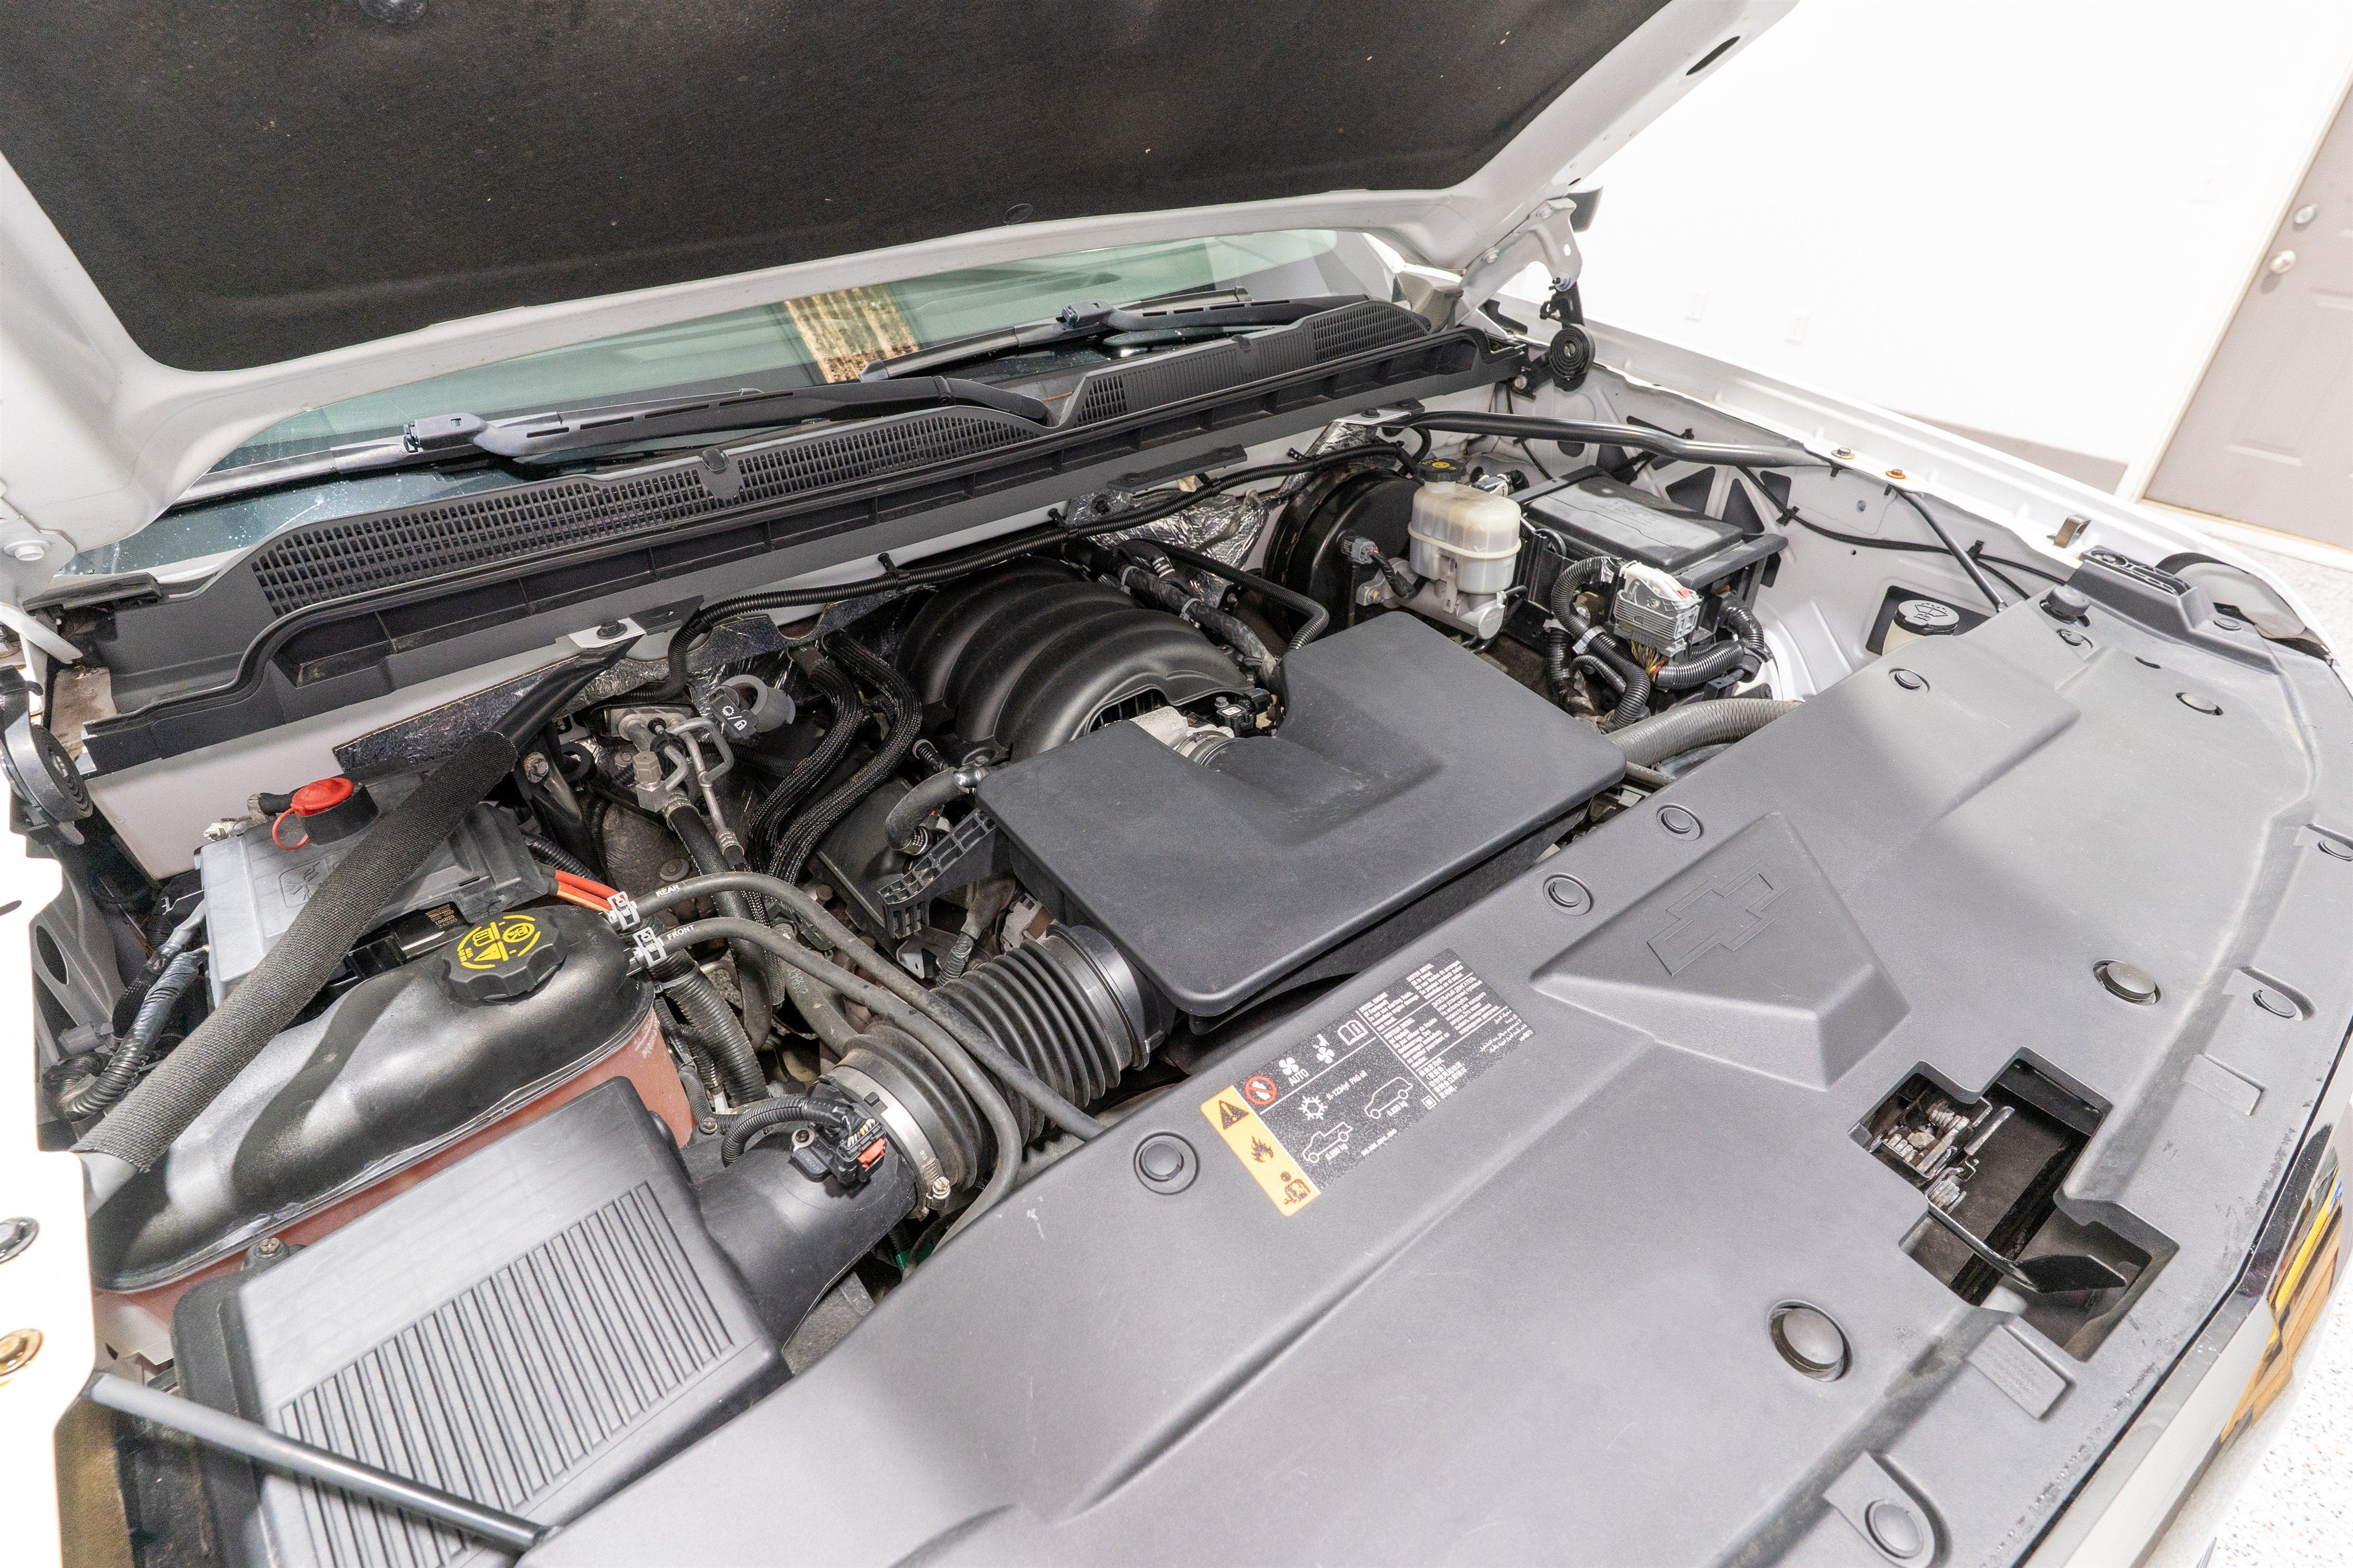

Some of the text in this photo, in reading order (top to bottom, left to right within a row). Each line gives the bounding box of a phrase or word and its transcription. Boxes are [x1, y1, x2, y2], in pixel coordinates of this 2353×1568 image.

[655, 884, 680, 897] REAR
[666, 924, 695, 941] FRONT
[1406, 963, 1434, 982] MOTOR DIESEL
[1426, 973, 1440, 982] fluidos
[1444, 960, 1461, 972] arranque.
[1425, 981, 1439, 992] pueden
[1437, 972, 1452, 984] producir
[1387, 998, 1403, 1009] starting
[1400, 991, 1413, 999] fluids.
[1431, 976, 1476, 1008] ДИЗЕЛЬНЫЙ ДВИГАТЕЛЬ
[1359, 992, 1388, 1012] DIESEL ENGINE
[1371, 994, 1419, 1026] Immediate engine damage
[1445, 1008, 1464, 1021] жидкости
[1468, 992, 1486, 1005] холодного
[1446, 997, 1468, 1013] используйте
[1469, 1002, 1482, 1011] может
[1383, 1016, 1397, 1026] result.
[1454, 1003, 1491, 1030] вызвать немедленное
[1459, 1017, 1482, 1034] повреждение
[1383, 1017, 1415, 1040] MOTEUR DIESEL
[1399, 1038, 1407, 1046] pas
[1406, 1029, 1419, 1040] utiliser
[1423, 1018, 1437, 1028] liquide
[1402, 1042, 1424, 1059] dommages
[1411, 1048, 1426, 1060] moteur
[1425, 1035, 1445, 1051] pourraient
[1418, 1057, 1444, 1076] 柴油发动机
[1288, 1068, 1309, 1086] AUTO
[1326, 1081, 1350, 1100] R-1234yf
[1349, 1074, 1361, 1084] PAG
[1337, 1141, 1348, 1150] kg
